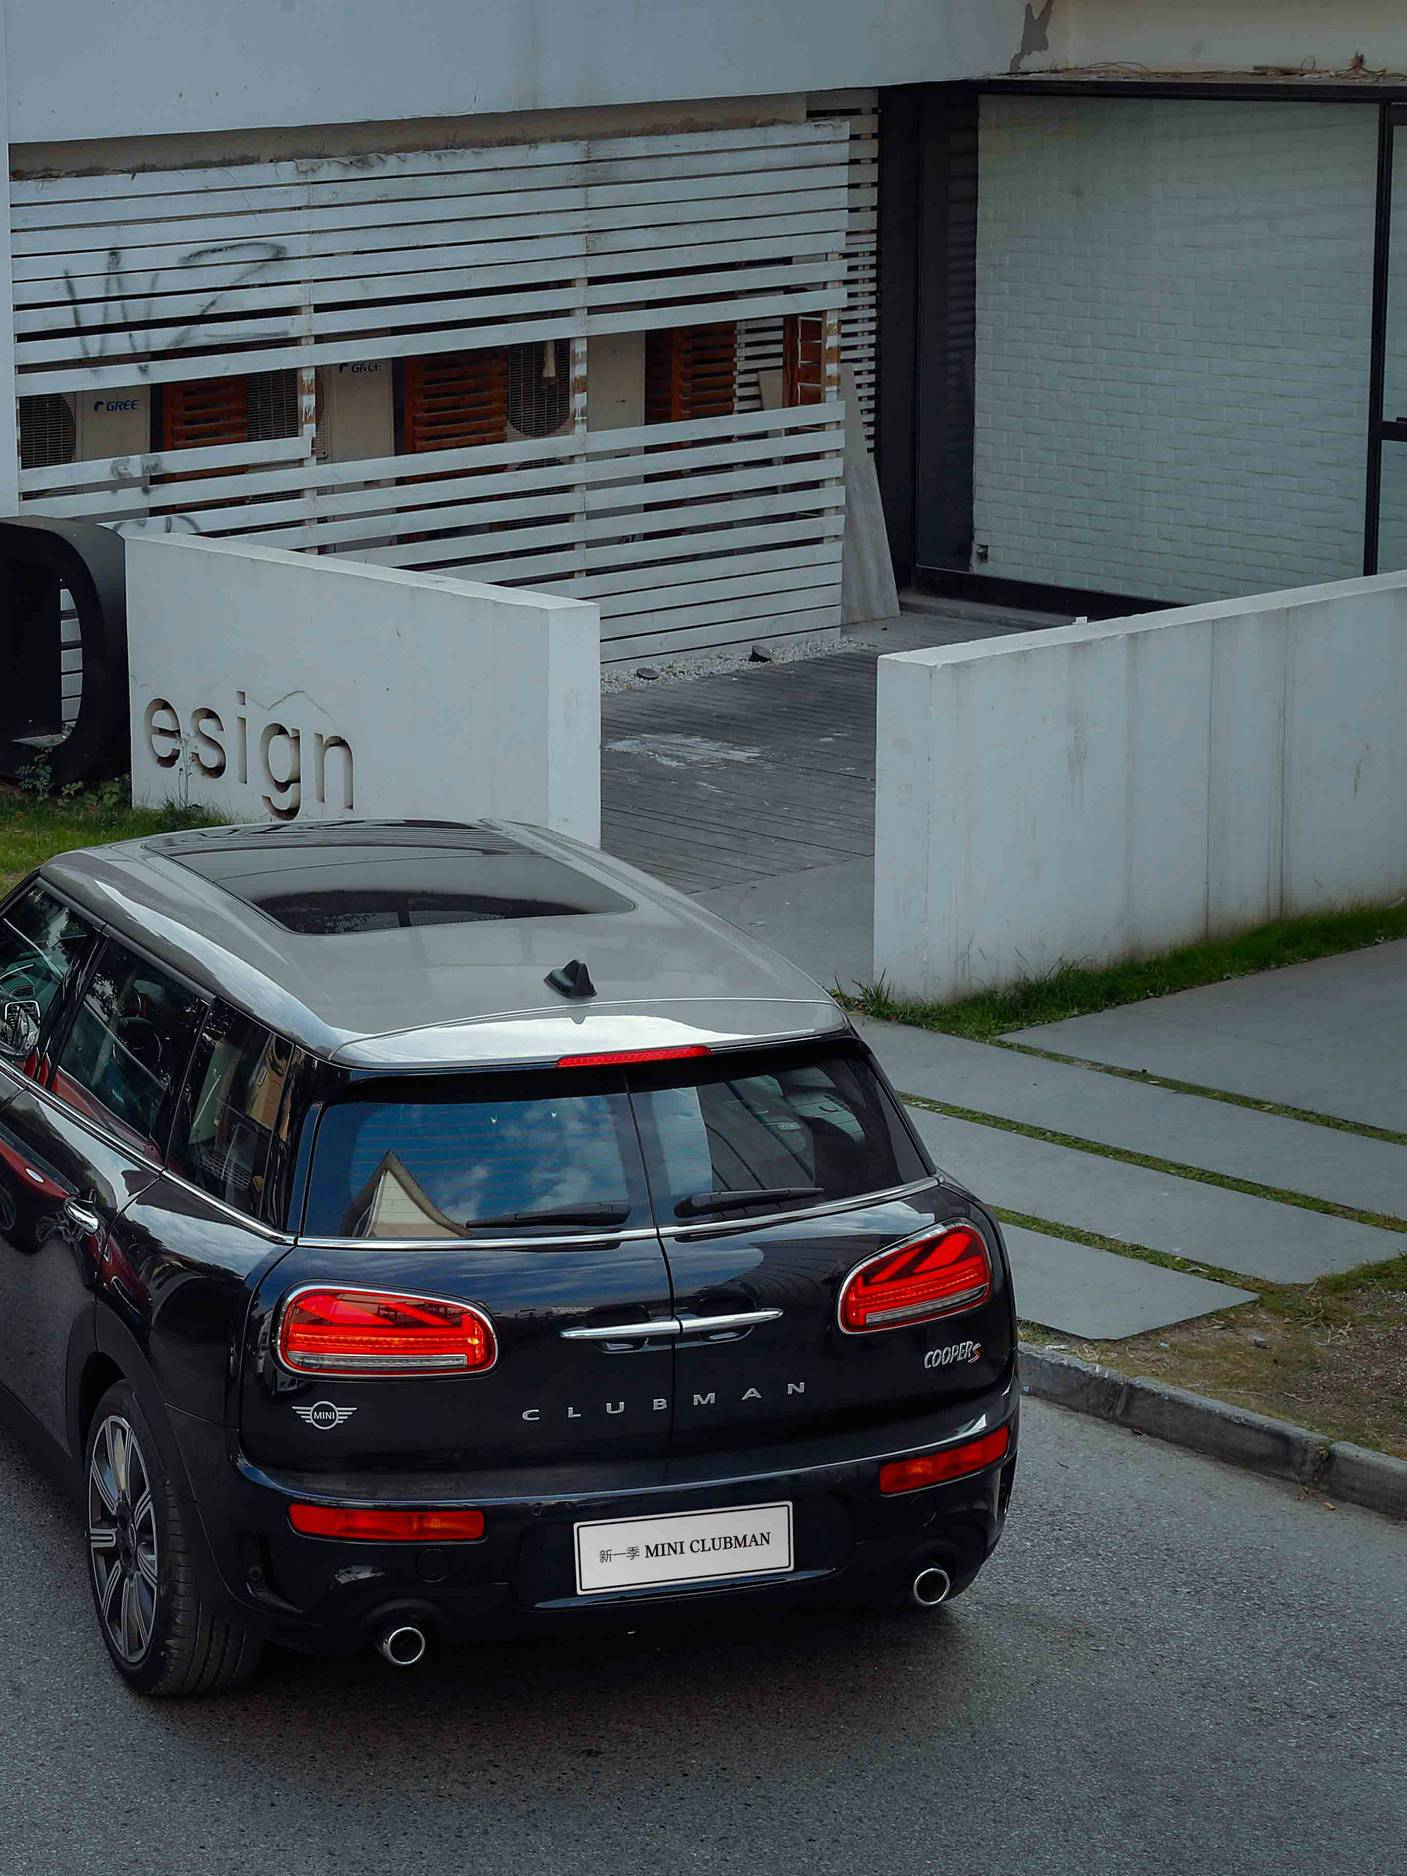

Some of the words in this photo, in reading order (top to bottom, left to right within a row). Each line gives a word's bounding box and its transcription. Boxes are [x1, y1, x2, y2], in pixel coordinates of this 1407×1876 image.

[106, 399, 140, 412] GREE
[521, 1381, 806, 1422] CLUBMAN
[313, 1411, 335, 1420] MINI
[599, 1545, 641, 1563] 新一季
[644, 1540, 686, 1559] MINI
[689, 1531, 772, 1553] CLUBMAN
